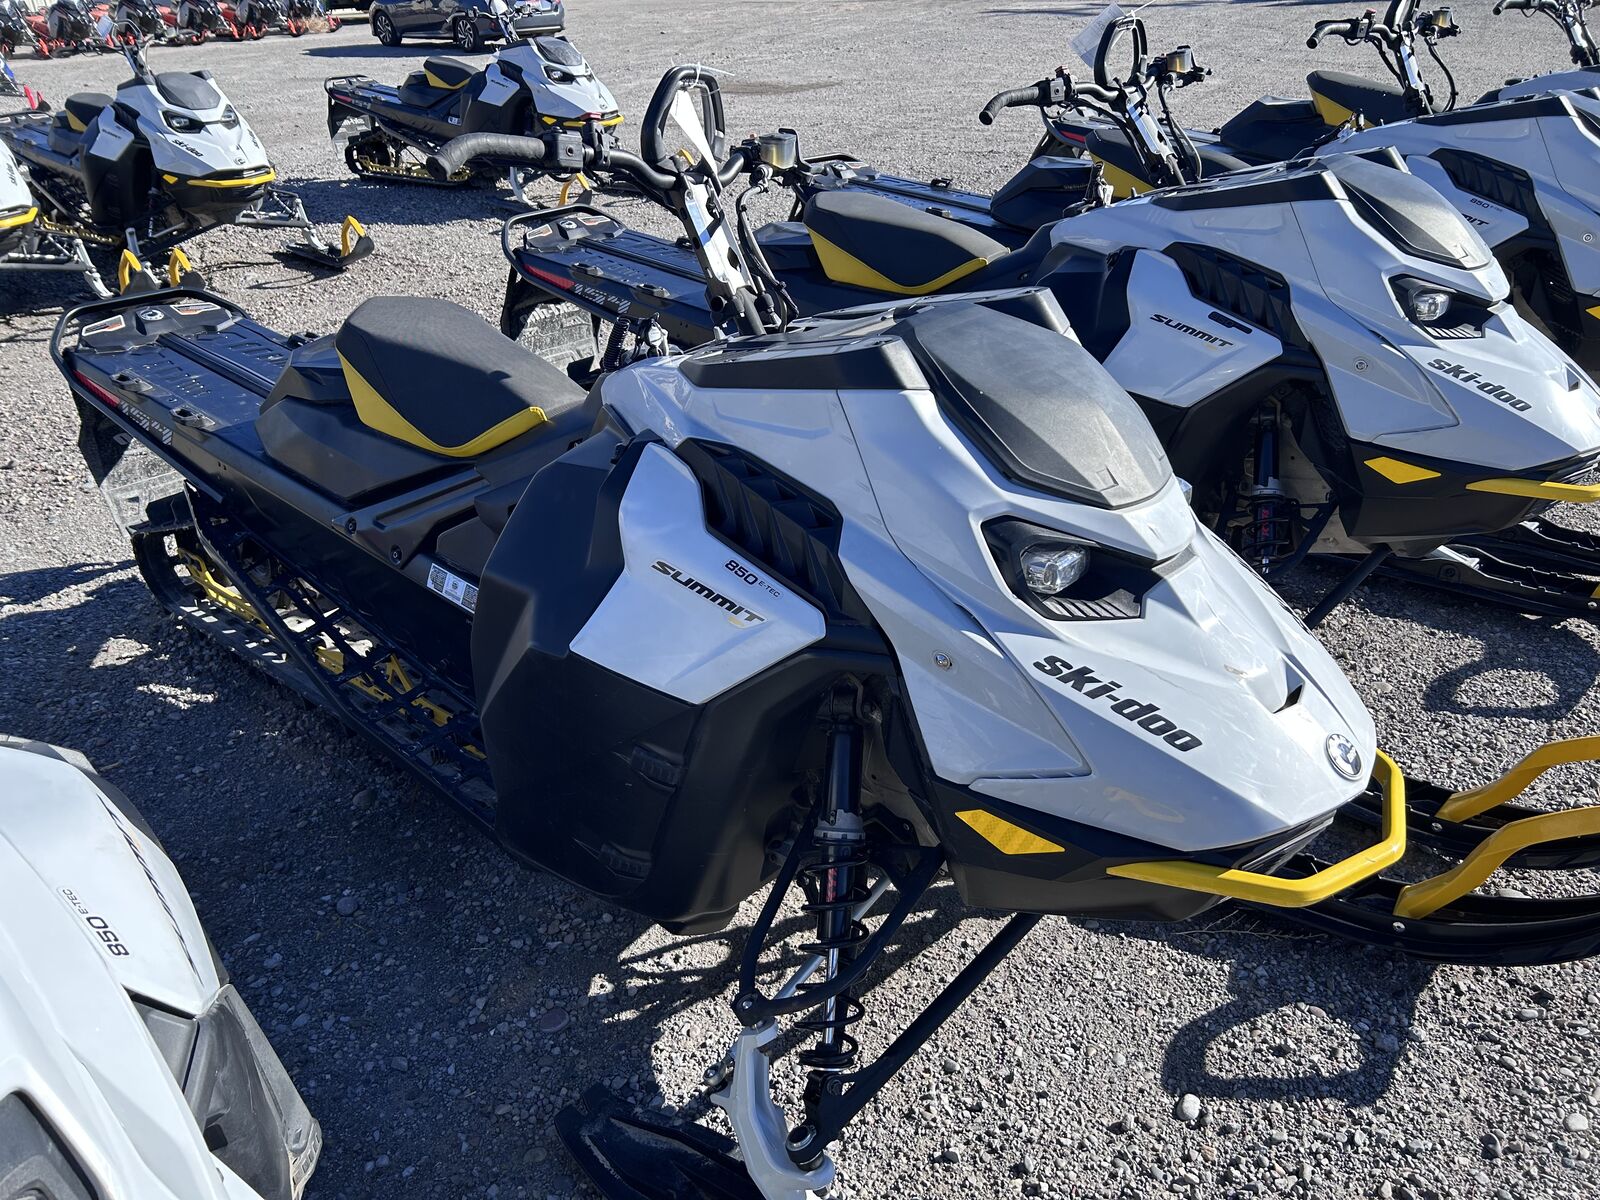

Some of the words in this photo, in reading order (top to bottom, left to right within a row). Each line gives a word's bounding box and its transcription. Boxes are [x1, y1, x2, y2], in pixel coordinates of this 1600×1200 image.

[1469, 197, 1490, 209] 850
[1150, 313, 1234, 348] SUMMIT
[1427, 357, 1532, 413] ski-doo
[651, 560, 765, 624] SUMMIT
[725, 559, 758, 586] 850
[758, 580, 781, 598] E-TEC
[1033, 654, 1203, 753] ski-doo
[62, 888, 88, 916] E-TEC
[86, 915, 130, 957] 850
